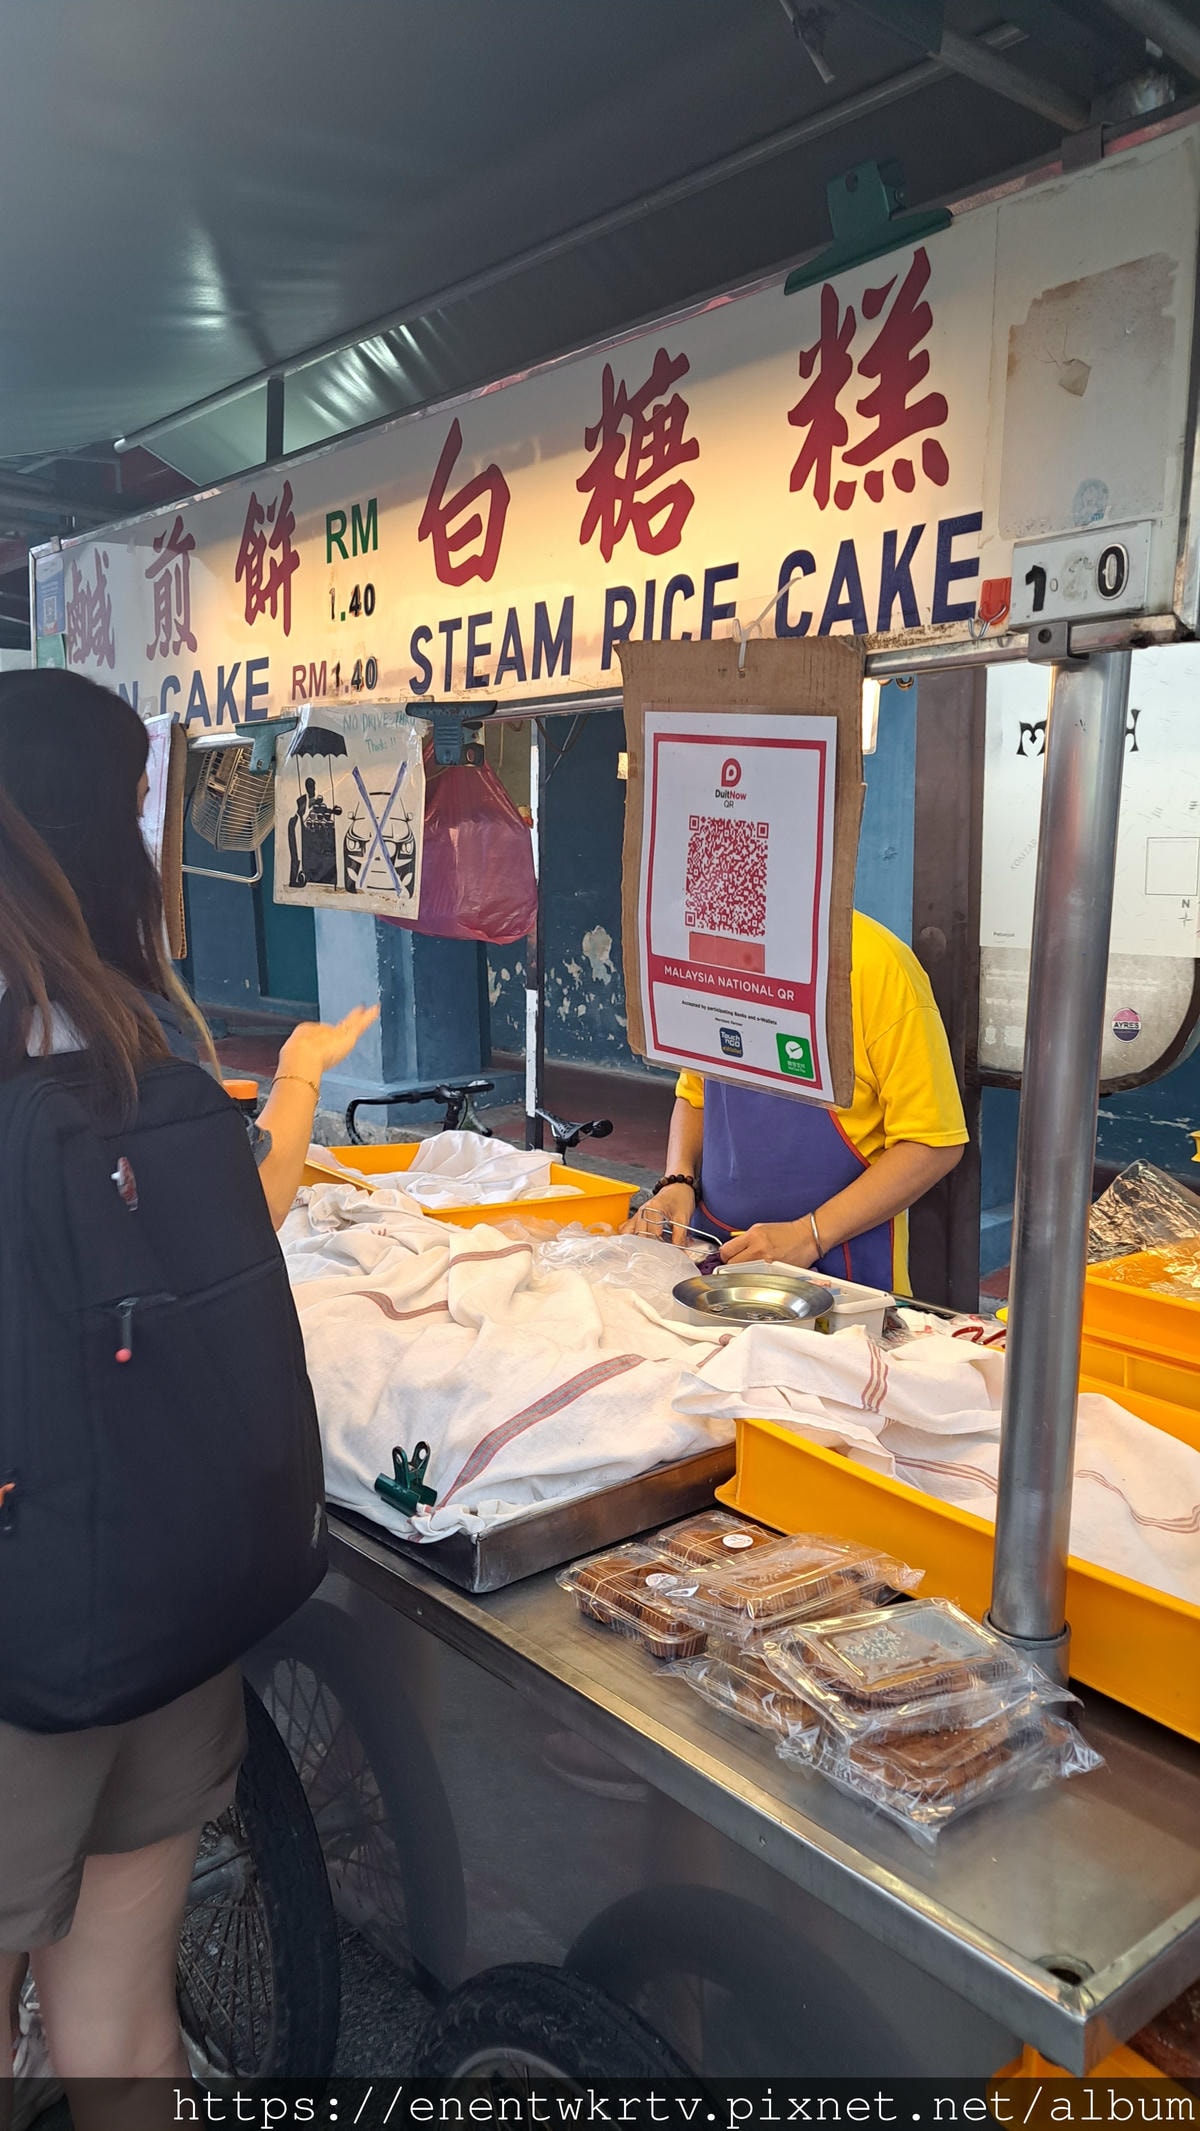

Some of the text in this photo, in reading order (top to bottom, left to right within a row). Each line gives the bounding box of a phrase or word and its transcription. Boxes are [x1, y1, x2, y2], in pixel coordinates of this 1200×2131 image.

[418, 247, 949, 588] 白糖糕
[326, 498, 378, 564] RM
[66, 480, 300, 670] 鹹煎餅
[328, 582, 376, 622] 1.40
[409, 511, 983, 695] STEAM RICE CAKE
[161, 656, 269, 728] CAKE
[344, 713, 358, 732] NO
[715, 789, 746, 800] DuitNow
[723, 800, 735, 809] QR
[1182, 899, 1191, 909] N
[664, 965, 795, 1001] MALAYSIA NATIONAL QR
[721, 1031, 740, 1042] Touch
